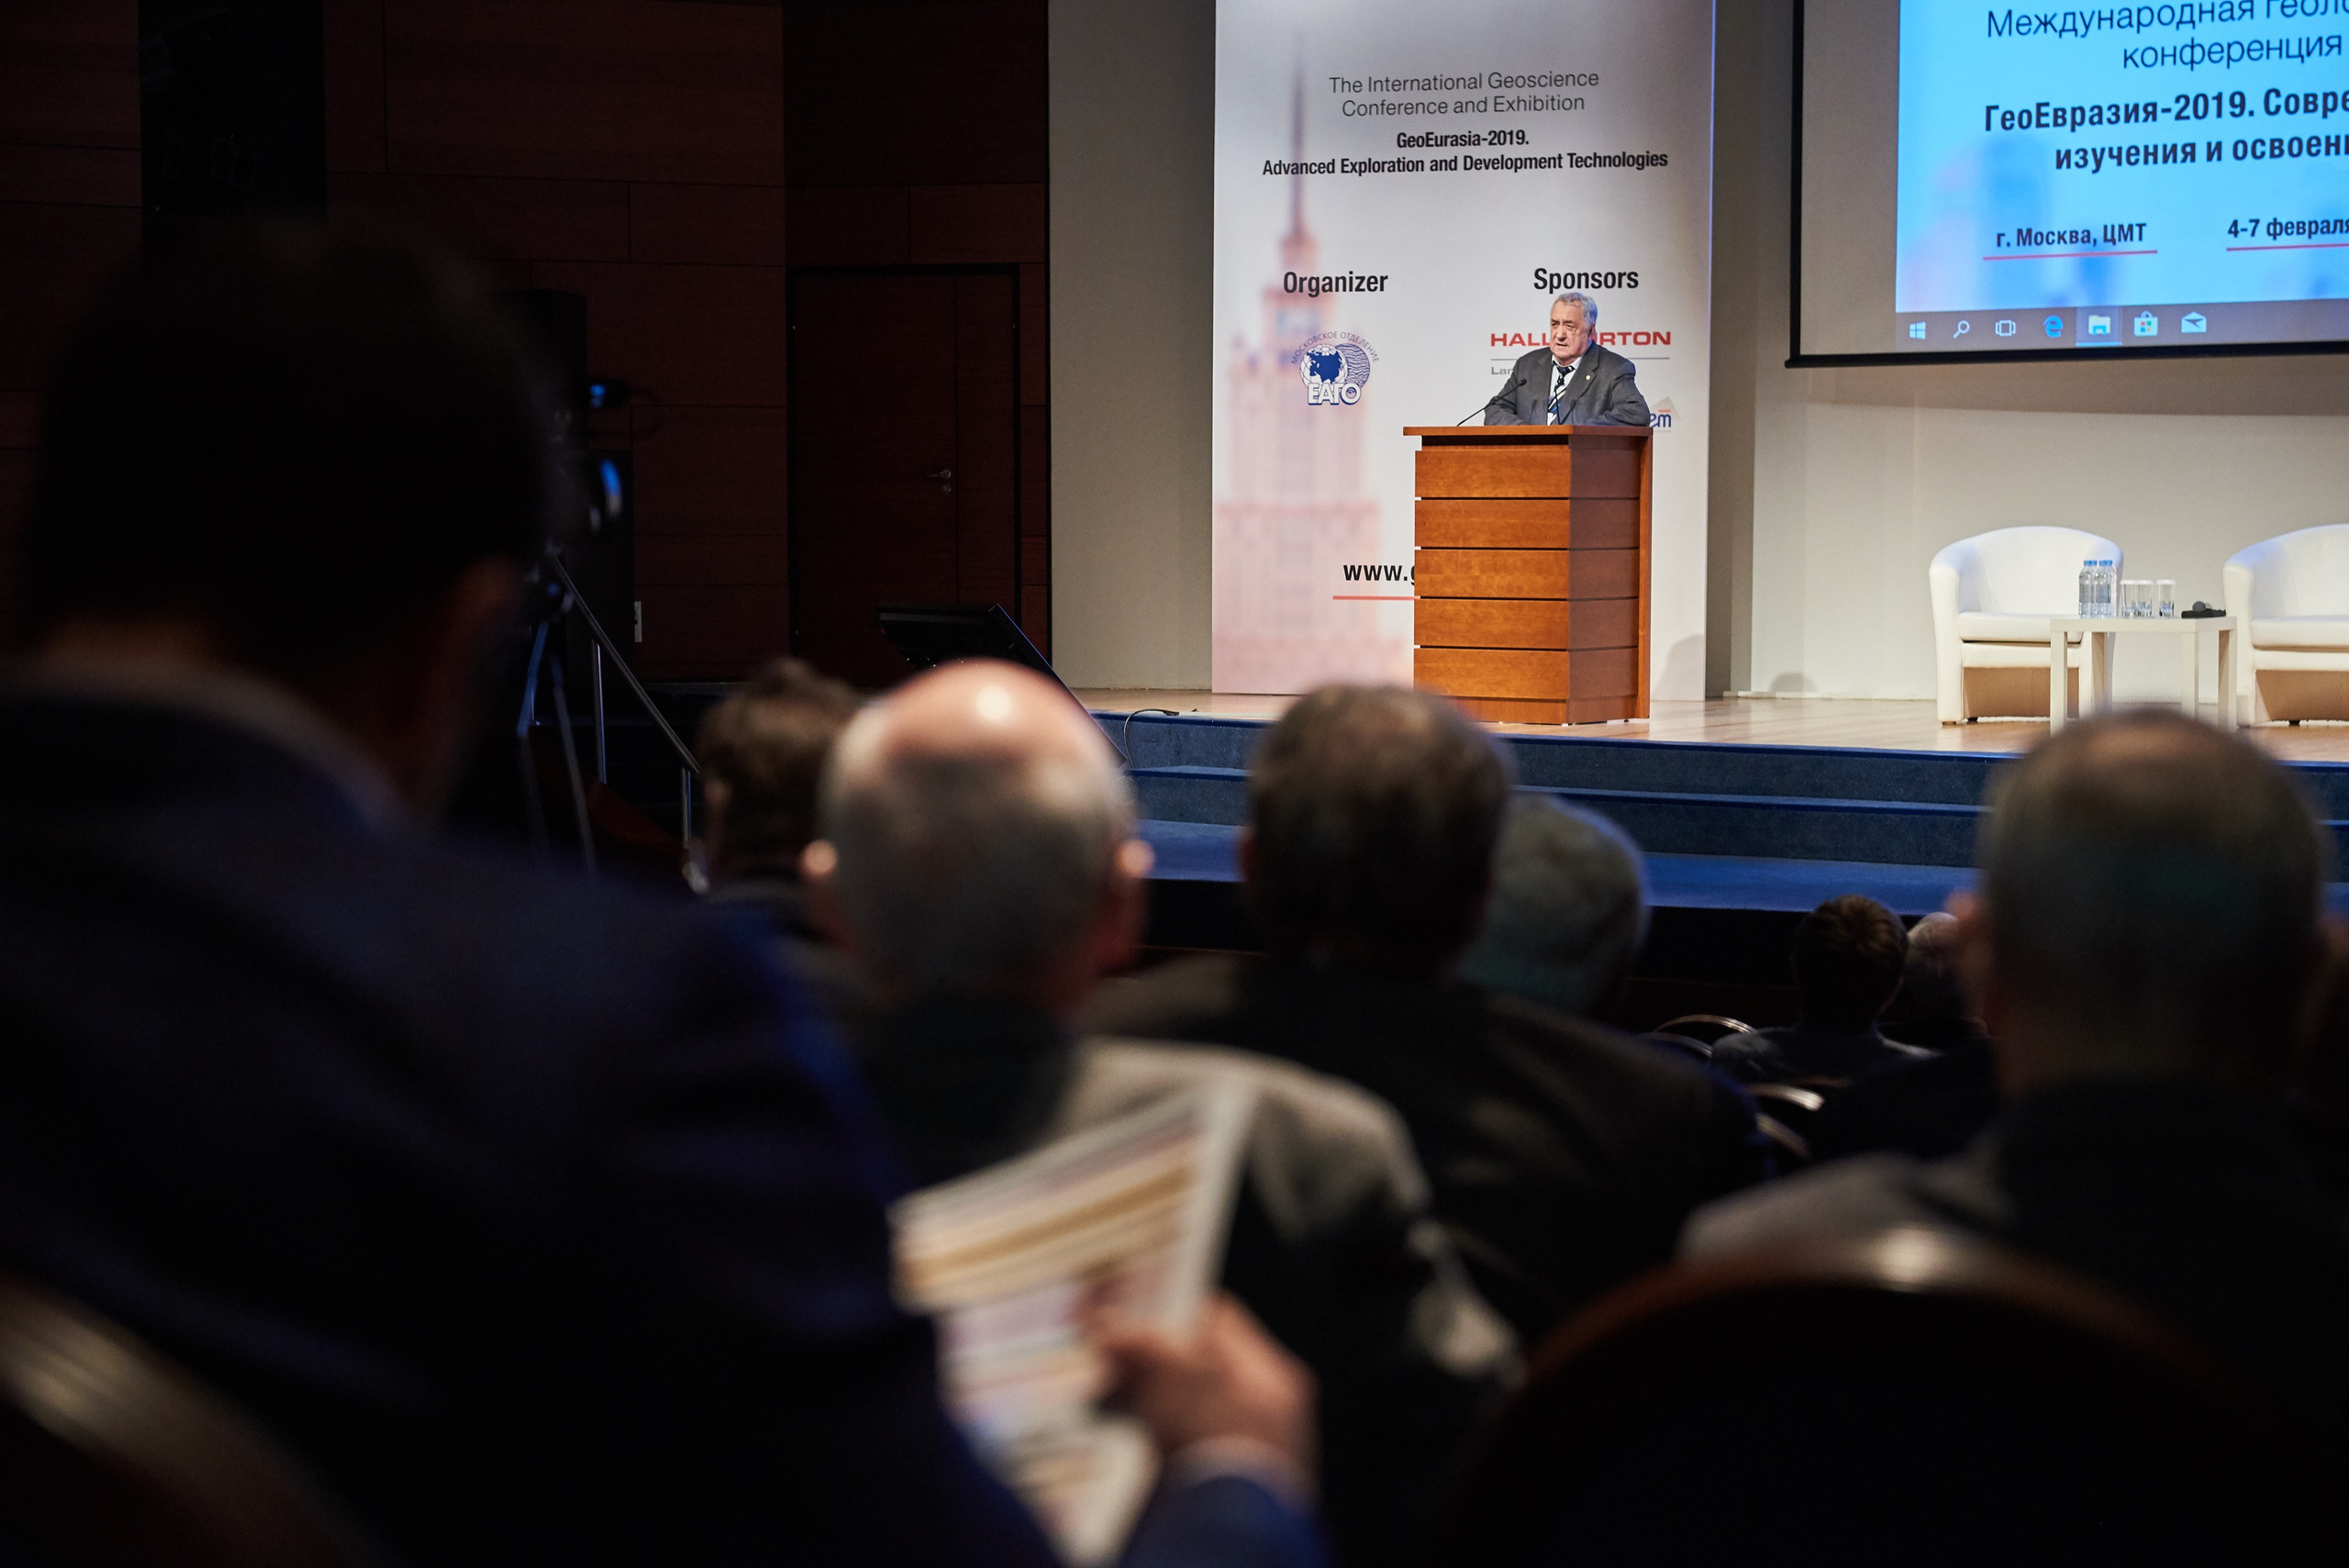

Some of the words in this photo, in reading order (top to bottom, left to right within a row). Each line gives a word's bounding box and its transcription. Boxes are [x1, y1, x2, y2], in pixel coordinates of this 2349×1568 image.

[1987, 0, 2254, 39] Международная
[2123, 36, 2342, 72] конференция
[1329, 77, 1363, 94] The
[1368, 72, 1483, 93] International
[1488, 71, 1599, 90] Geoscience
[1342, 98, 1448, 117] Conference
[1453, 96, 1488, 114] and
[1494, 95, 1586, 113] Exhibition
[1985, 91, 2254, 132] ГеоЕвразия-2019.
[1396, 129, 1530, 149] GeoEurasia-2019.
[1262, 160, 1336, 175] Advanced
[1340, 157, 1425, 175] Exploration
[1430, 156, 1458, 172] and
[1463, 154, 1564, 174] Development
[1567, 150, 1668, 172] Technologies
[2055, 142, 2197, 174] изучения
[2206, 140, 2222, 162] и
[1996, 233, 2010, 248] г.
[2016, 228, 2098, 248] Москва,
[2102, 223, 2147, 246] ЦМТ
[2228, 218, 2260, 239] 4-7
[1283, 272, 1388, 298] Organizer
[1533, 268, 1640, 294] Sponsors
[1291, 331, 1338, 364] МОСКОВСКОЕ
[1340, 331, 1380, 362] ОТДЕЛЕНИЕ
[1308, 383, 1362, 406] ЕАГО
